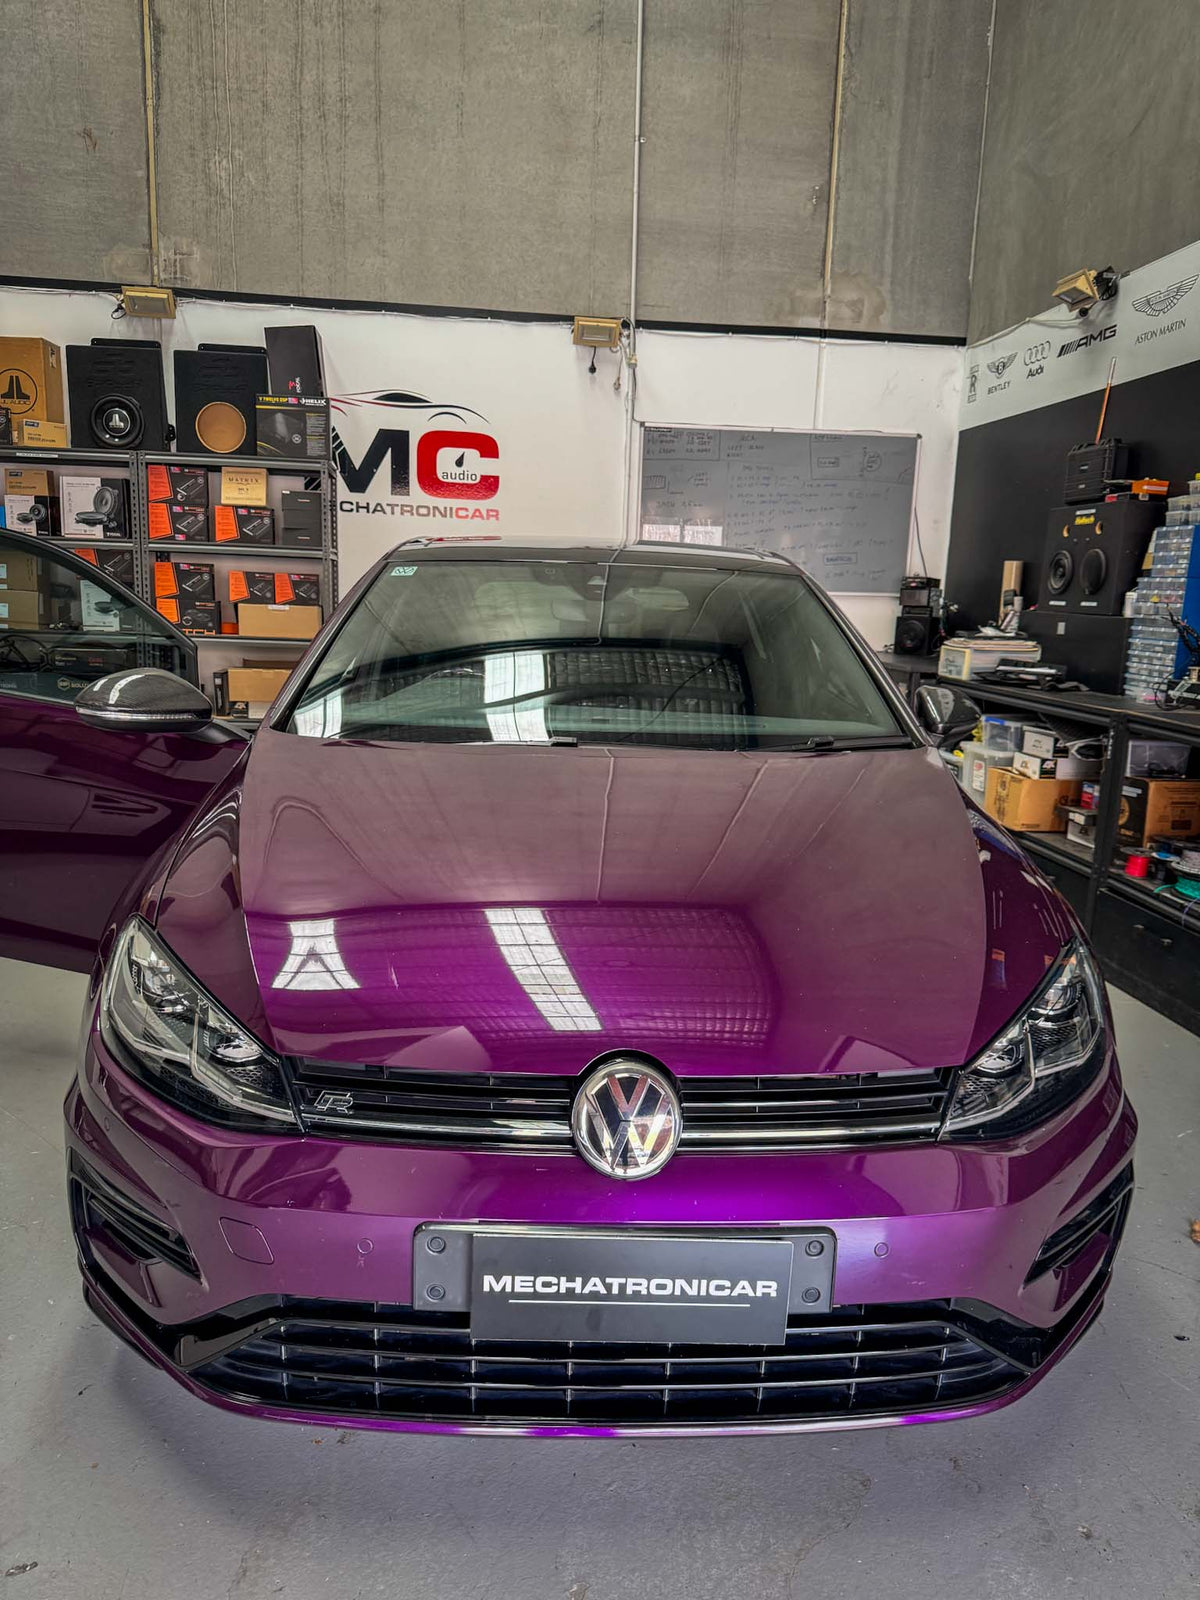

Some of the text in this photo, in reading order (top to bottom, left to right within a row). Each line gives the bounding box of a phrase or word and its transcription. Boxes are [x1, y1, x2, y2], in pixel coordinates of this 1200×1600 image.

[1135, 318, 1187, 345] ASTON MARTIN
[1026, 364, 1044, 379] Audi
[987, 380, 1011, 395] BENTLEY
[441, 470, 478, 482] audio
[482, 1274, 778, 1298] MECHATRONICAR
